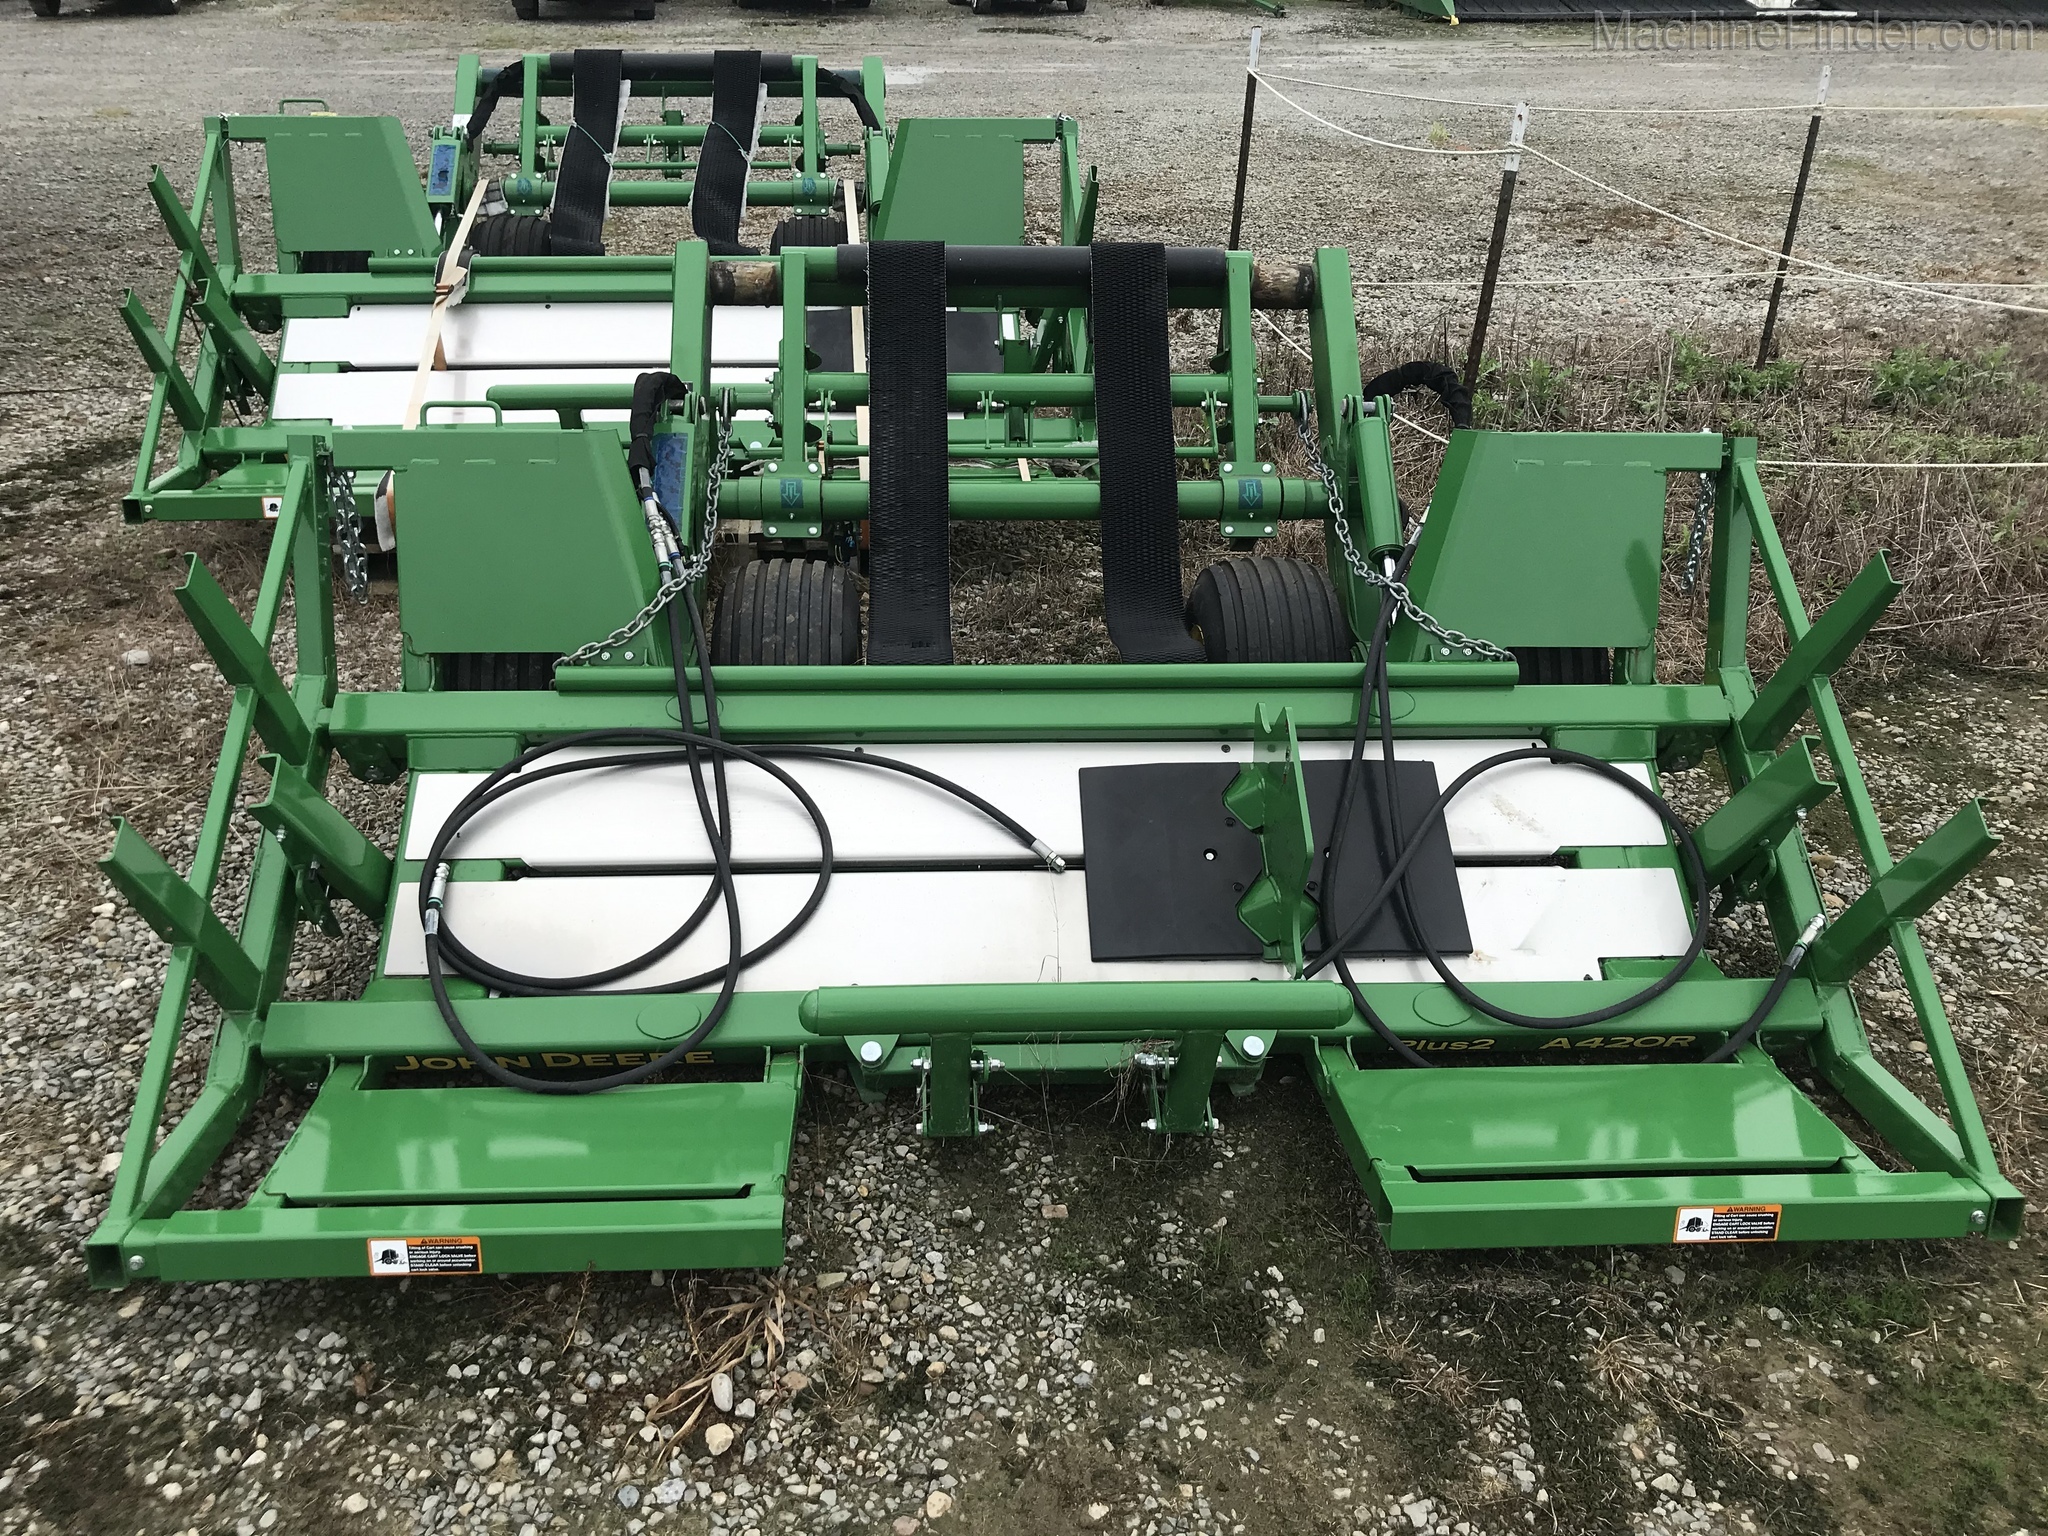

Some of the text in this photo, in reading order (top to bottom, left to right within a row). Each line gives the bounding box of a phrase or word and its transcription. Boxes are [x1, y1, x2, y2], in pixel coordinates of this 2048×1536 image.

[1388, 1036, 1696, 1051] Plus2 A420R
[395, 1055, 531, 1071] JOHN
